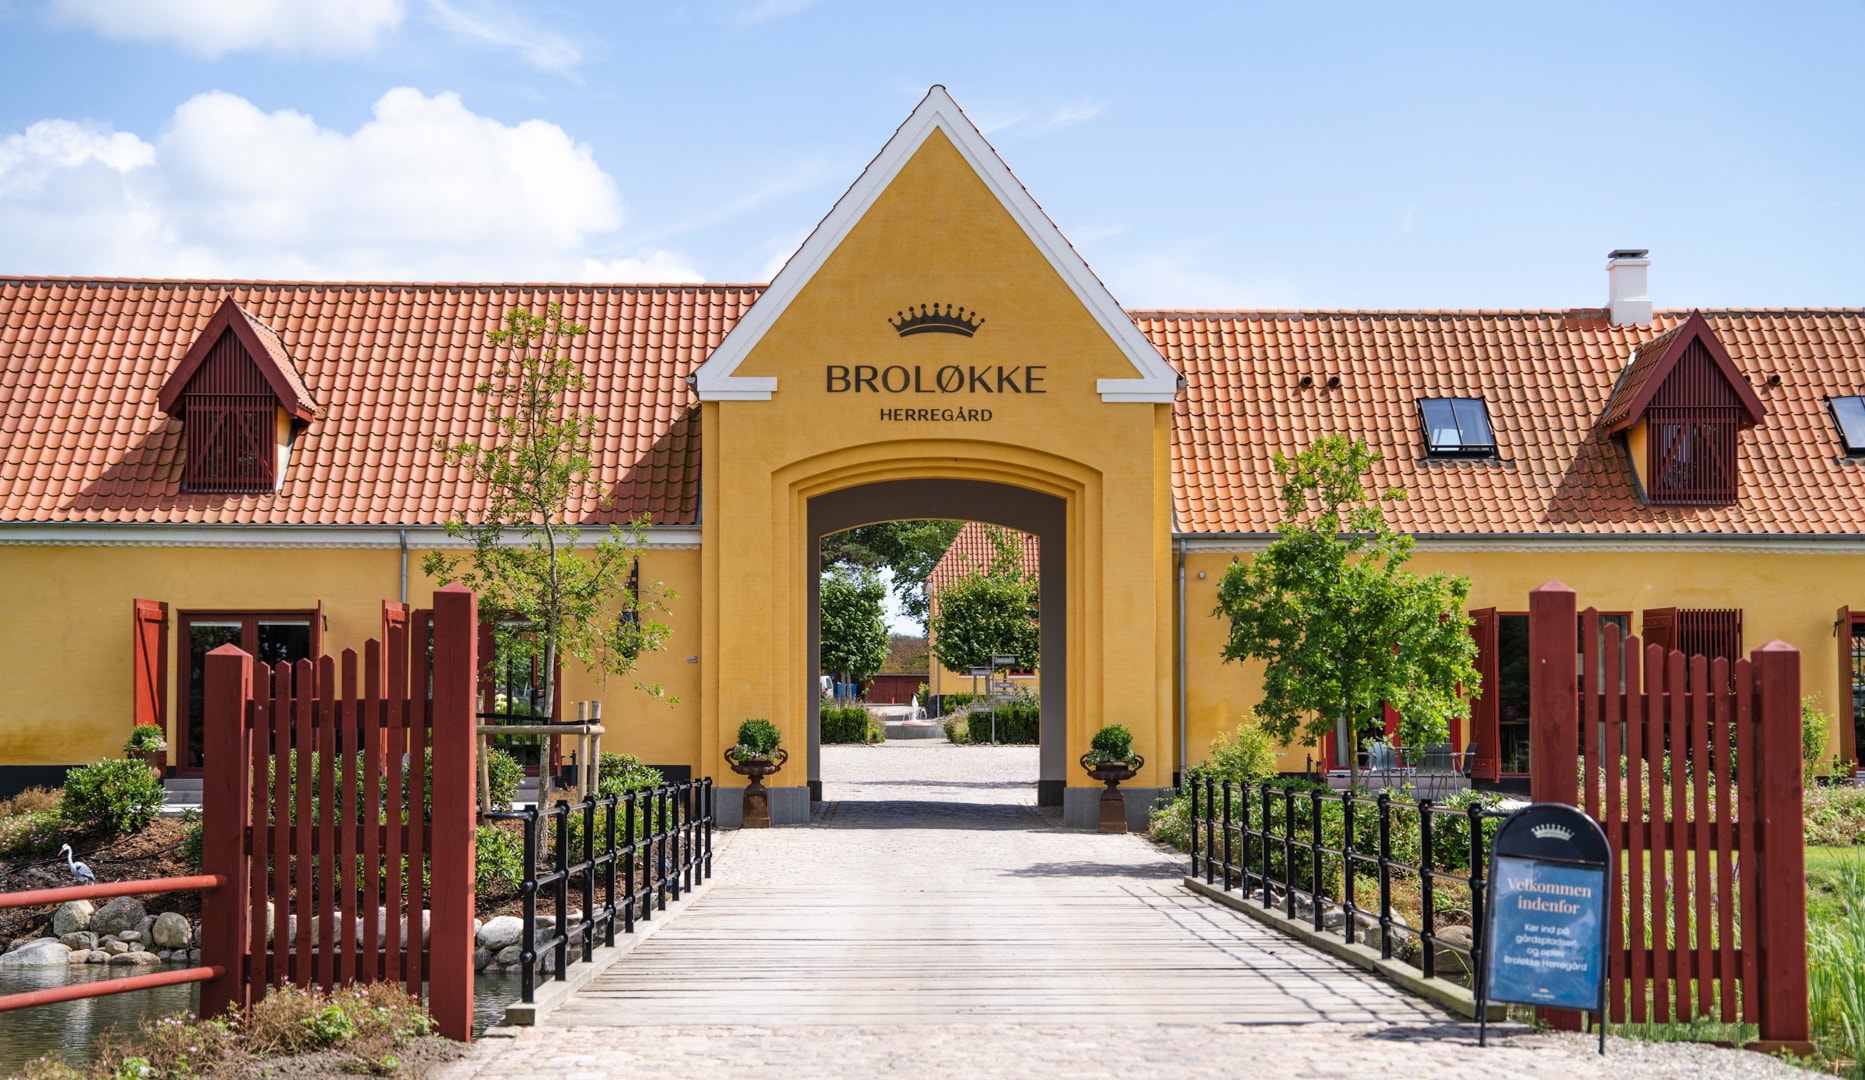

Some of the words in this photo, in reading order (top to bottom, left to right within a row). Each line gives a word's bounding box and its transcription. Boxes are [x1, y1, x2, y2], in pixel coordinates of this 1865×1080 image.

[826, 365, 1047, 394] BROLØKKE
[880, 406, 993, 422] HERREGÅRD
[1508, 877, 1592, 898] Velkommen
[1518, 896, 1580, 915] indenfor
[1541, 925, 1555, 934] ind
[1557, 926, 1570, 936] på
[1526, 947, 1539, 957] og
[1542, 959, 1587, 972] Herregård
